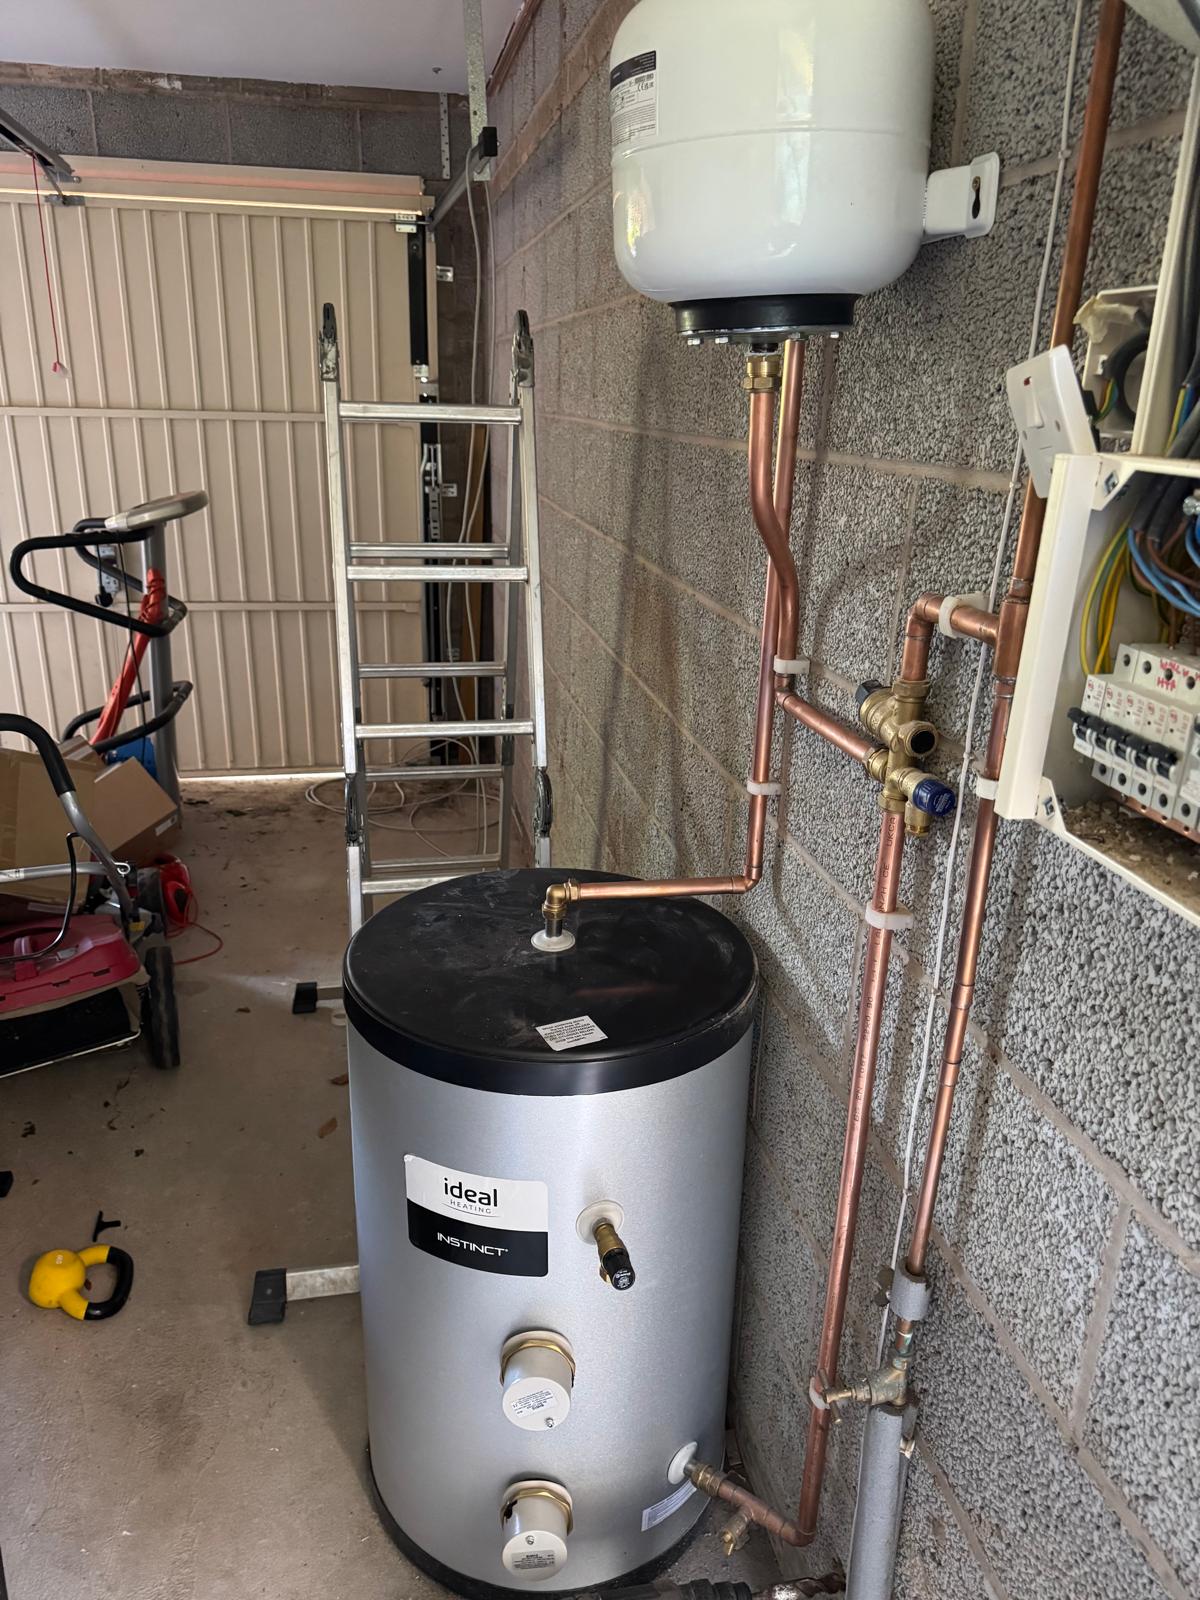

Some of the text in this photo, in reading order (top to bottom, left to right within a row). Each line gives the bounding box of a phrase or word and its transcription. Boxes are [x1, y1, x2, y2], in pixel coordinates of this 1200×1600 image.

[882, 863, 890, 878] CE
[886, 816, 897, 847] UKCA
[444, 1177, 498, 1207] ideal
[450, 1199, 492, 1215] HEATING
[437, 1232, 505, 1256] INSTINCT
